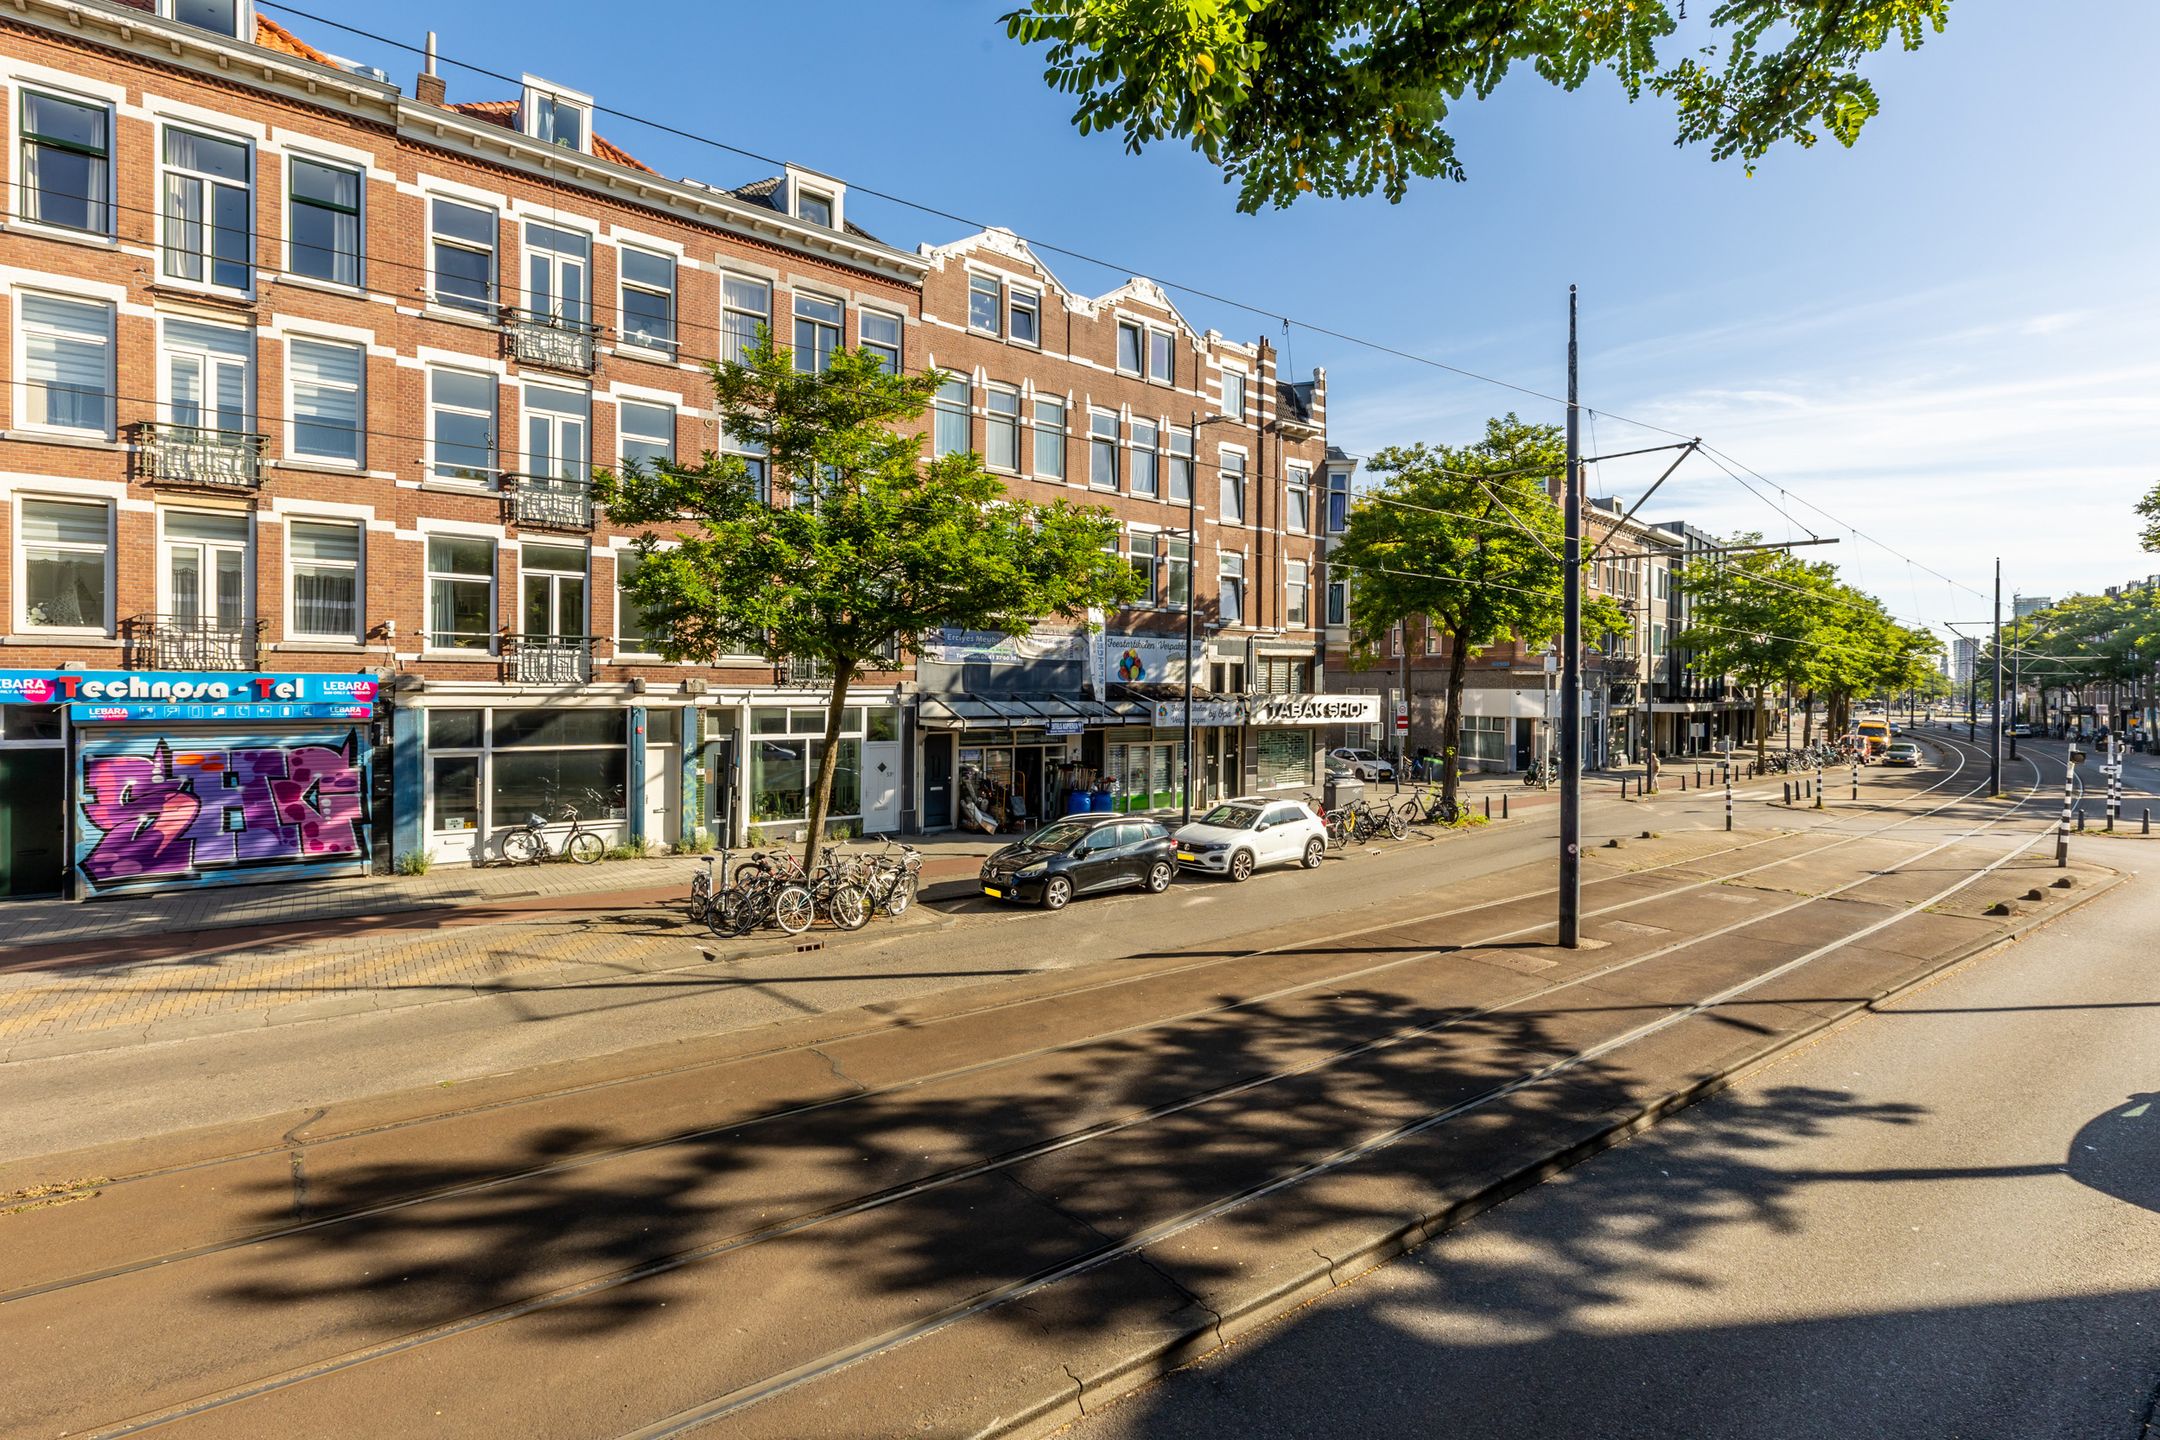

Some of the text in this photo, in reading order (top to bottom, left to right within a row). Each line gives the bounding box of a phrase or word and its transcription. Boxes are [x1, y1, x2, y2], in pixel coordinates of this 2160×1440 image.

[59, 676, 229, 698] Technosa
[256, 677, 304, 698] Tel
[323, 681, 371, 690] LEBARA
[1267, 702, 1369, 719] TABAK SHOP
